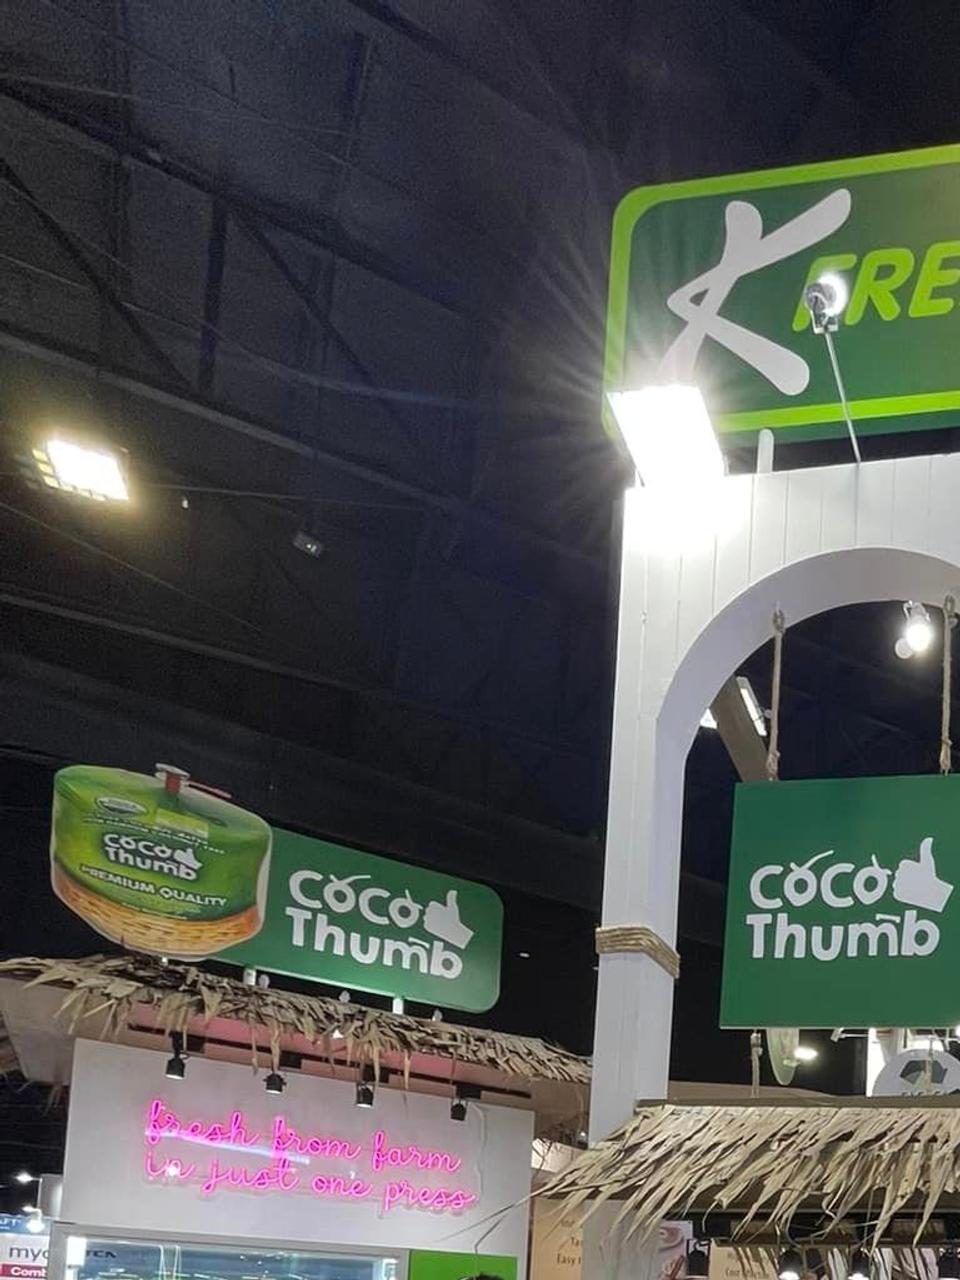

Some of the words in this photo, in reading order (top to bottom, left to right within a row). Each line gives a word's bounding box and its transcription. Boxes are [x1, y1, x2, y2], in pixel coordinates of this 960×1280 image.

[104, 846, 197, 880] Thumb
[159, 887, 228, 906] QUALITY
[285, 907, 463, 979] Thumb
[746, 909, 940, 961] Thumb
[147, 1100, 259, 1143] fresh
[272, 1117, 361, 1160] from
[373, 1132, 460, 1171] farm
[147, 1153, 193, 1176] in
[203, 1157, 299, 1191] just
[311, 1170, 373, 1197] one
[384, 1181, 475, 1209] press
